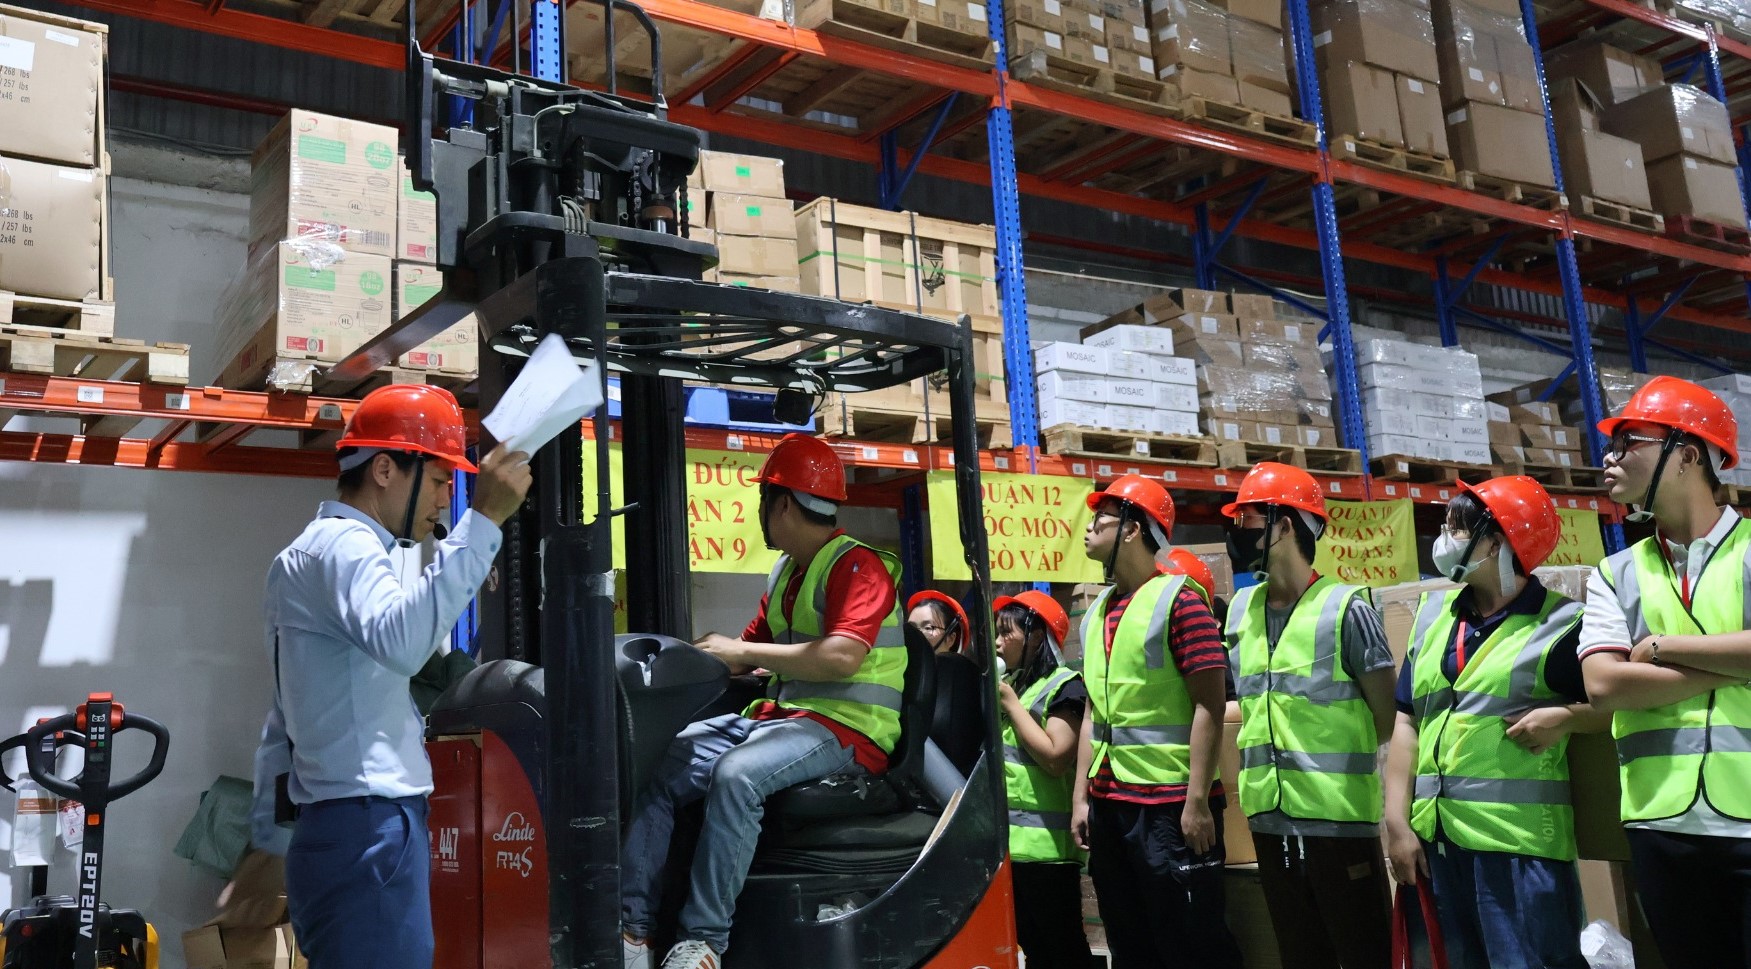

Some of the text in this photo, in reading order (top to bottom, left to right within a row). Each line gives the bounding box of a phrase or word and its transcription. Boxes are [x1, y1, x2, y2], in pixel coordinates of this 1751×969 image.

[19, 81, 29, 91] lbs
[20, 96, 31, 104] cm
[23, 210, 33, 221] lbs
[22, 223, 32, 234] lbs
[23, 239, 34, 247] cm
[341, 317, 350, 325] HL
[1094, 336, 1115, 348] OSAIC
[1066, 351, 1096, 363] MOSAIC
[1160, 364, 1188, 376] MOSAIC
[1114, 385, 1145, 397] MOSAIC
[1462, 426, 1482, 436] MOSAIC
[1464, 449, 1486, 459] MOSAIC
[693, 456, 756, 488] ĐỨC
[1043, 486, 1062, 507] 12
[687, 494, 745, 528] ẬN 2
[1327, 504, 1378, 524] QUẬN
[983, 509, 1072, 540] ÓC MÔN
[688, 532, 747, 566] ẬN 9
[1330, 544, 1394, 562] QUẬN 5
[1019, 544, 1064, 572] VẤP
[1575, 553, 1582, 565] 4
[1337, 565, 1397, 583] QUẬN 8
[492, 811, 536, 842] Linde
[439, 827, 459, 860] 447
[79, 852, 98, 939] EPT20V
